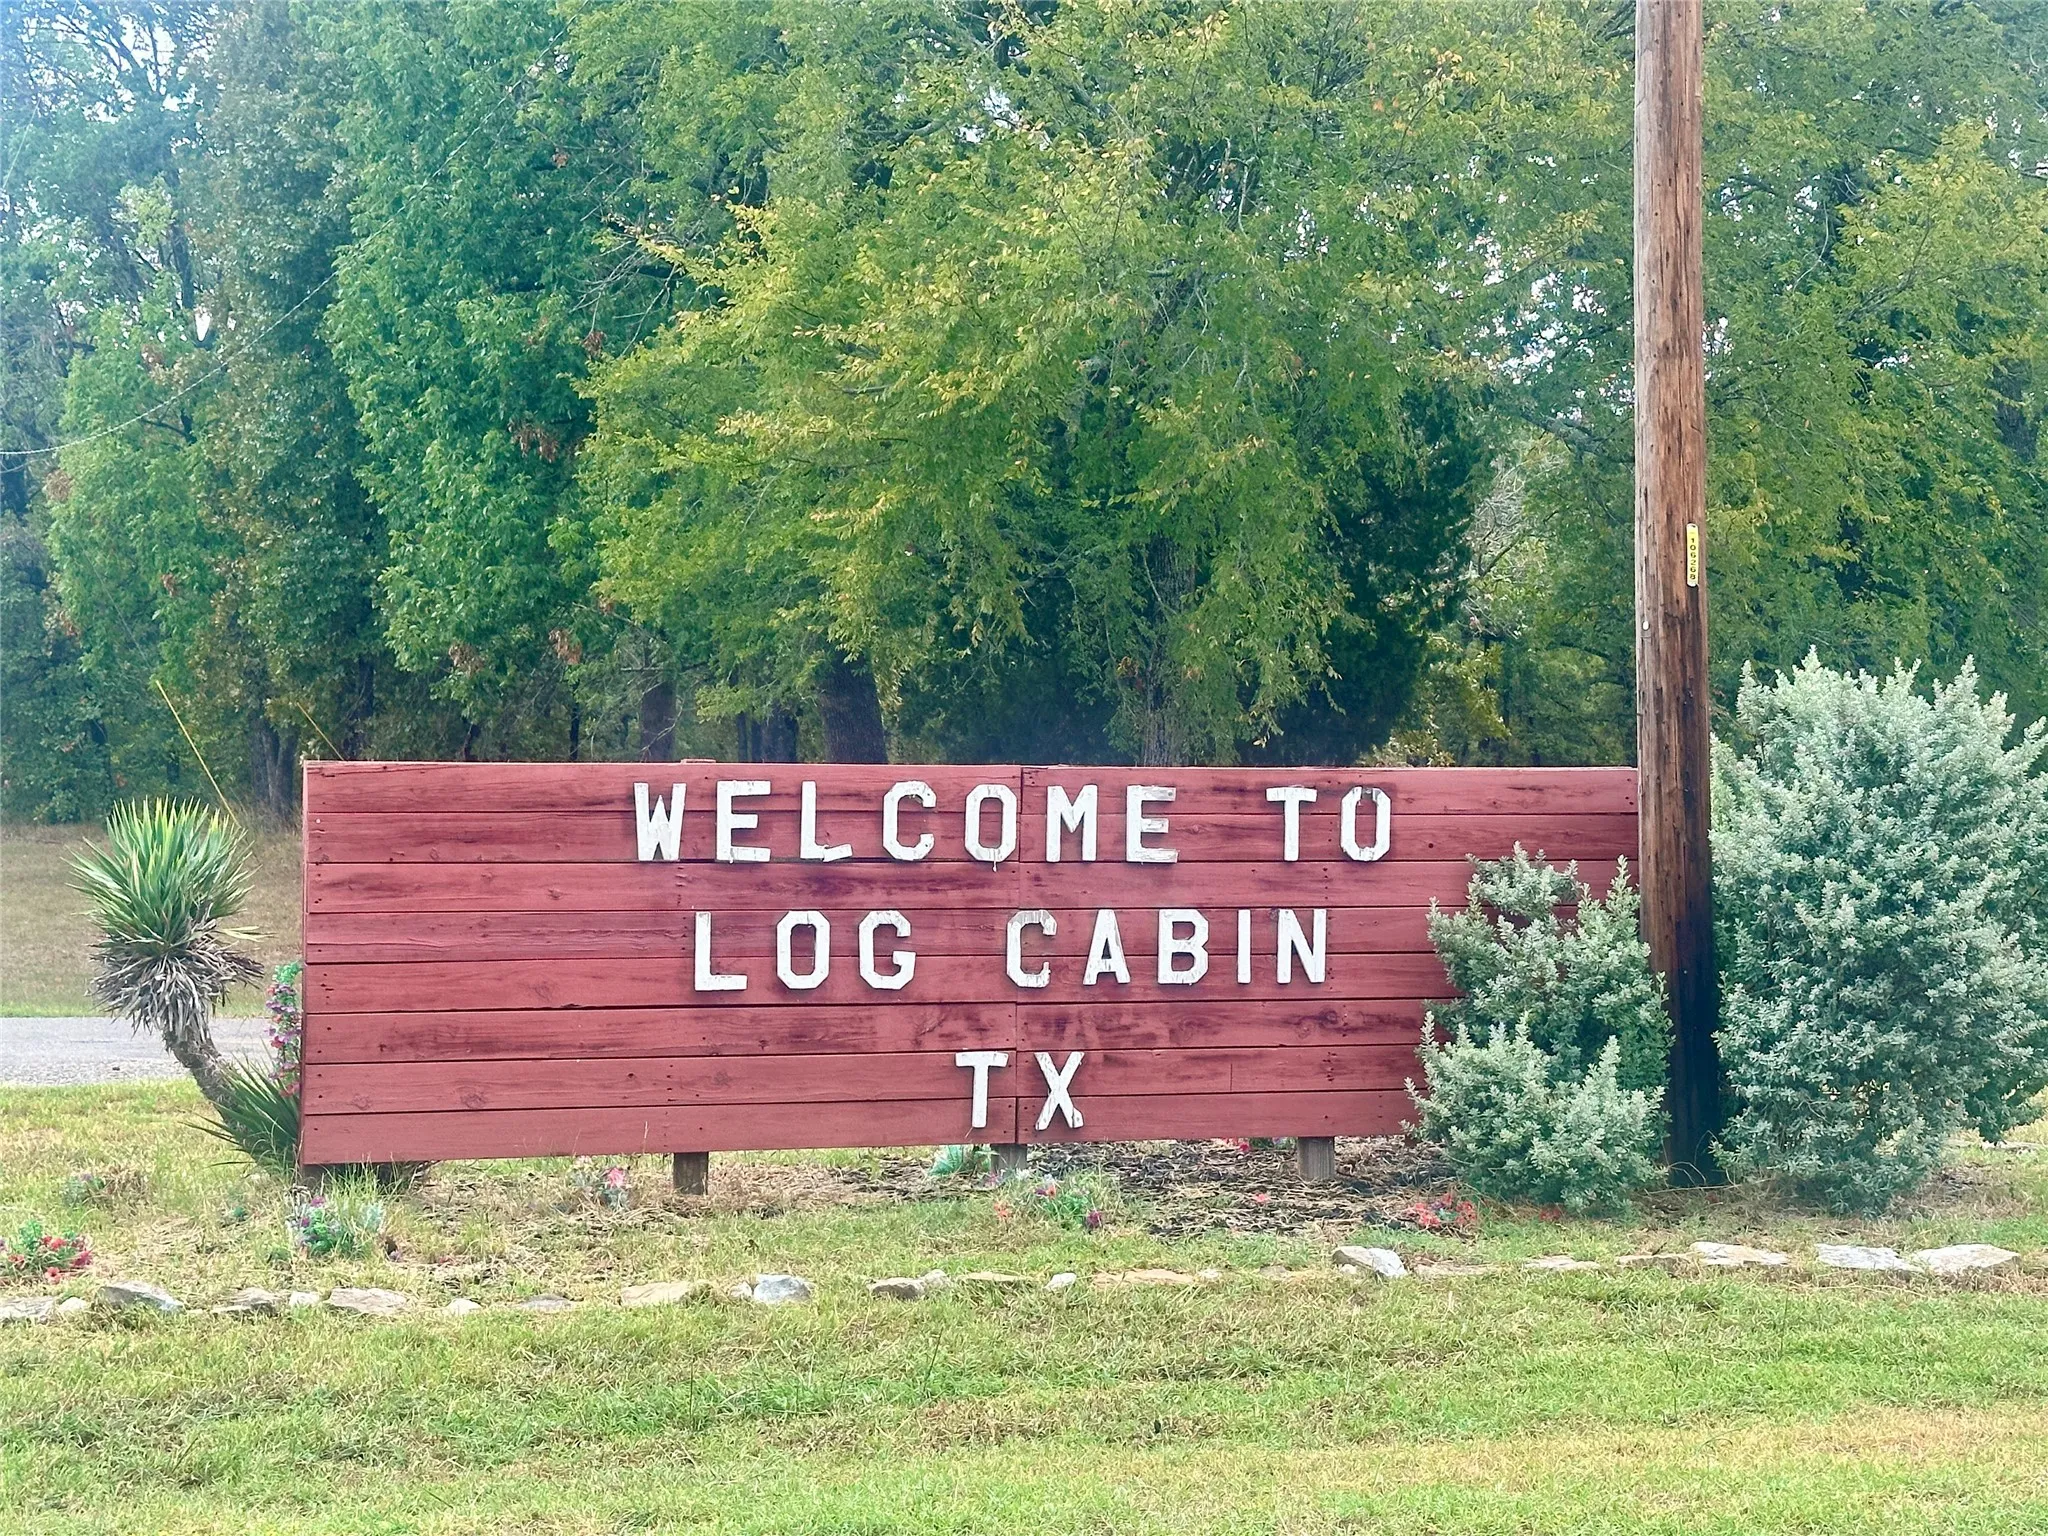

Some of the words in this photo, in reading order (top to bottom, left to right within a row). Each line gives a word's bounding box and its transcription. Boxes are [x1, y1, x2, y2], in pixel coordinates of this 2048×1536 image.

[633, 779, 1179, 865] WELCOME
[1265, 785, 1393, 863] TO
[693, 909, 917, 992] LOG
[1006, 908, 1328, 989] CABIN
[954, 1050, 1086, 1132] TX
